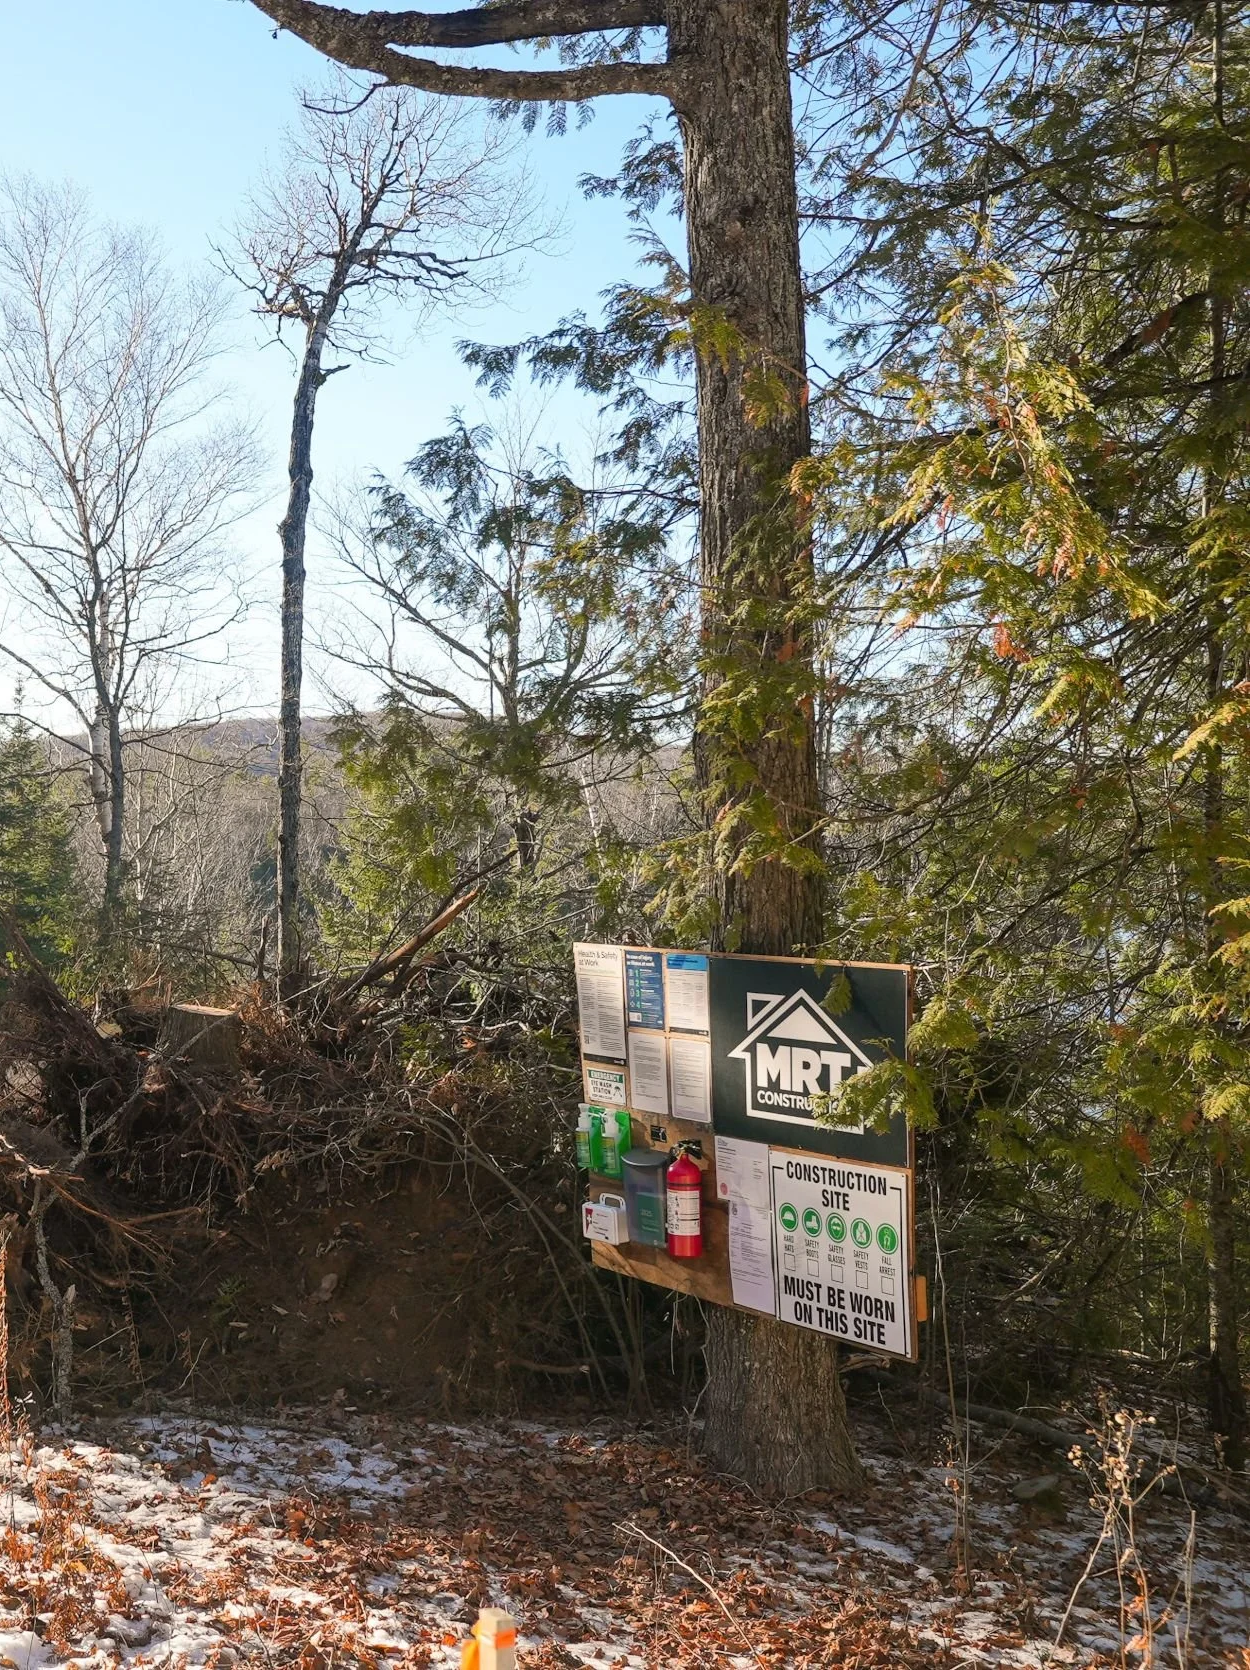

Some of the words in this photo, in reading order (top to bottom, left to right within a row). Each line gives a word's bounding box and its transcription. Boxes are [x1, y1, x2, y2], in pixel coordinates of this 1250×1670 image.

[635, 979, 639, 987] 2
[635, 989, 640, 997] 3
[756, 1042, 852, 1097] MRT
[786, 1160, 887, 1196] CONSTRUCTION
[822, 1189, 850, 1211] SITE
[784, 1234, 794, 1243] HARD
[785, 1244, 794, 1253] HATS
[805, 1239, 819, 1249] SAFETY
[829, 1244, 844, 1254] SAFETY
[806, 1249, 819, 1259] BOOTS
[853, 1250, 868, 1260] SAFETY
[828, 1254, 845, 1265] GLASSES
[882, 1256, 892, 1266] FALL
[855, 1260, 868, 1270] VESTS
[879, 1266, 896, 1276] ARREST
[784, 1275, 822, 1304] MUST
[827, 1286, 845, 1310] BE
[850, 1291, 896, 1323] WORN
[794, 1301, 812, 1325] ON
[816, 1307, 848, 1335] THIS
[853, 1317, 886, 1345] SITE
